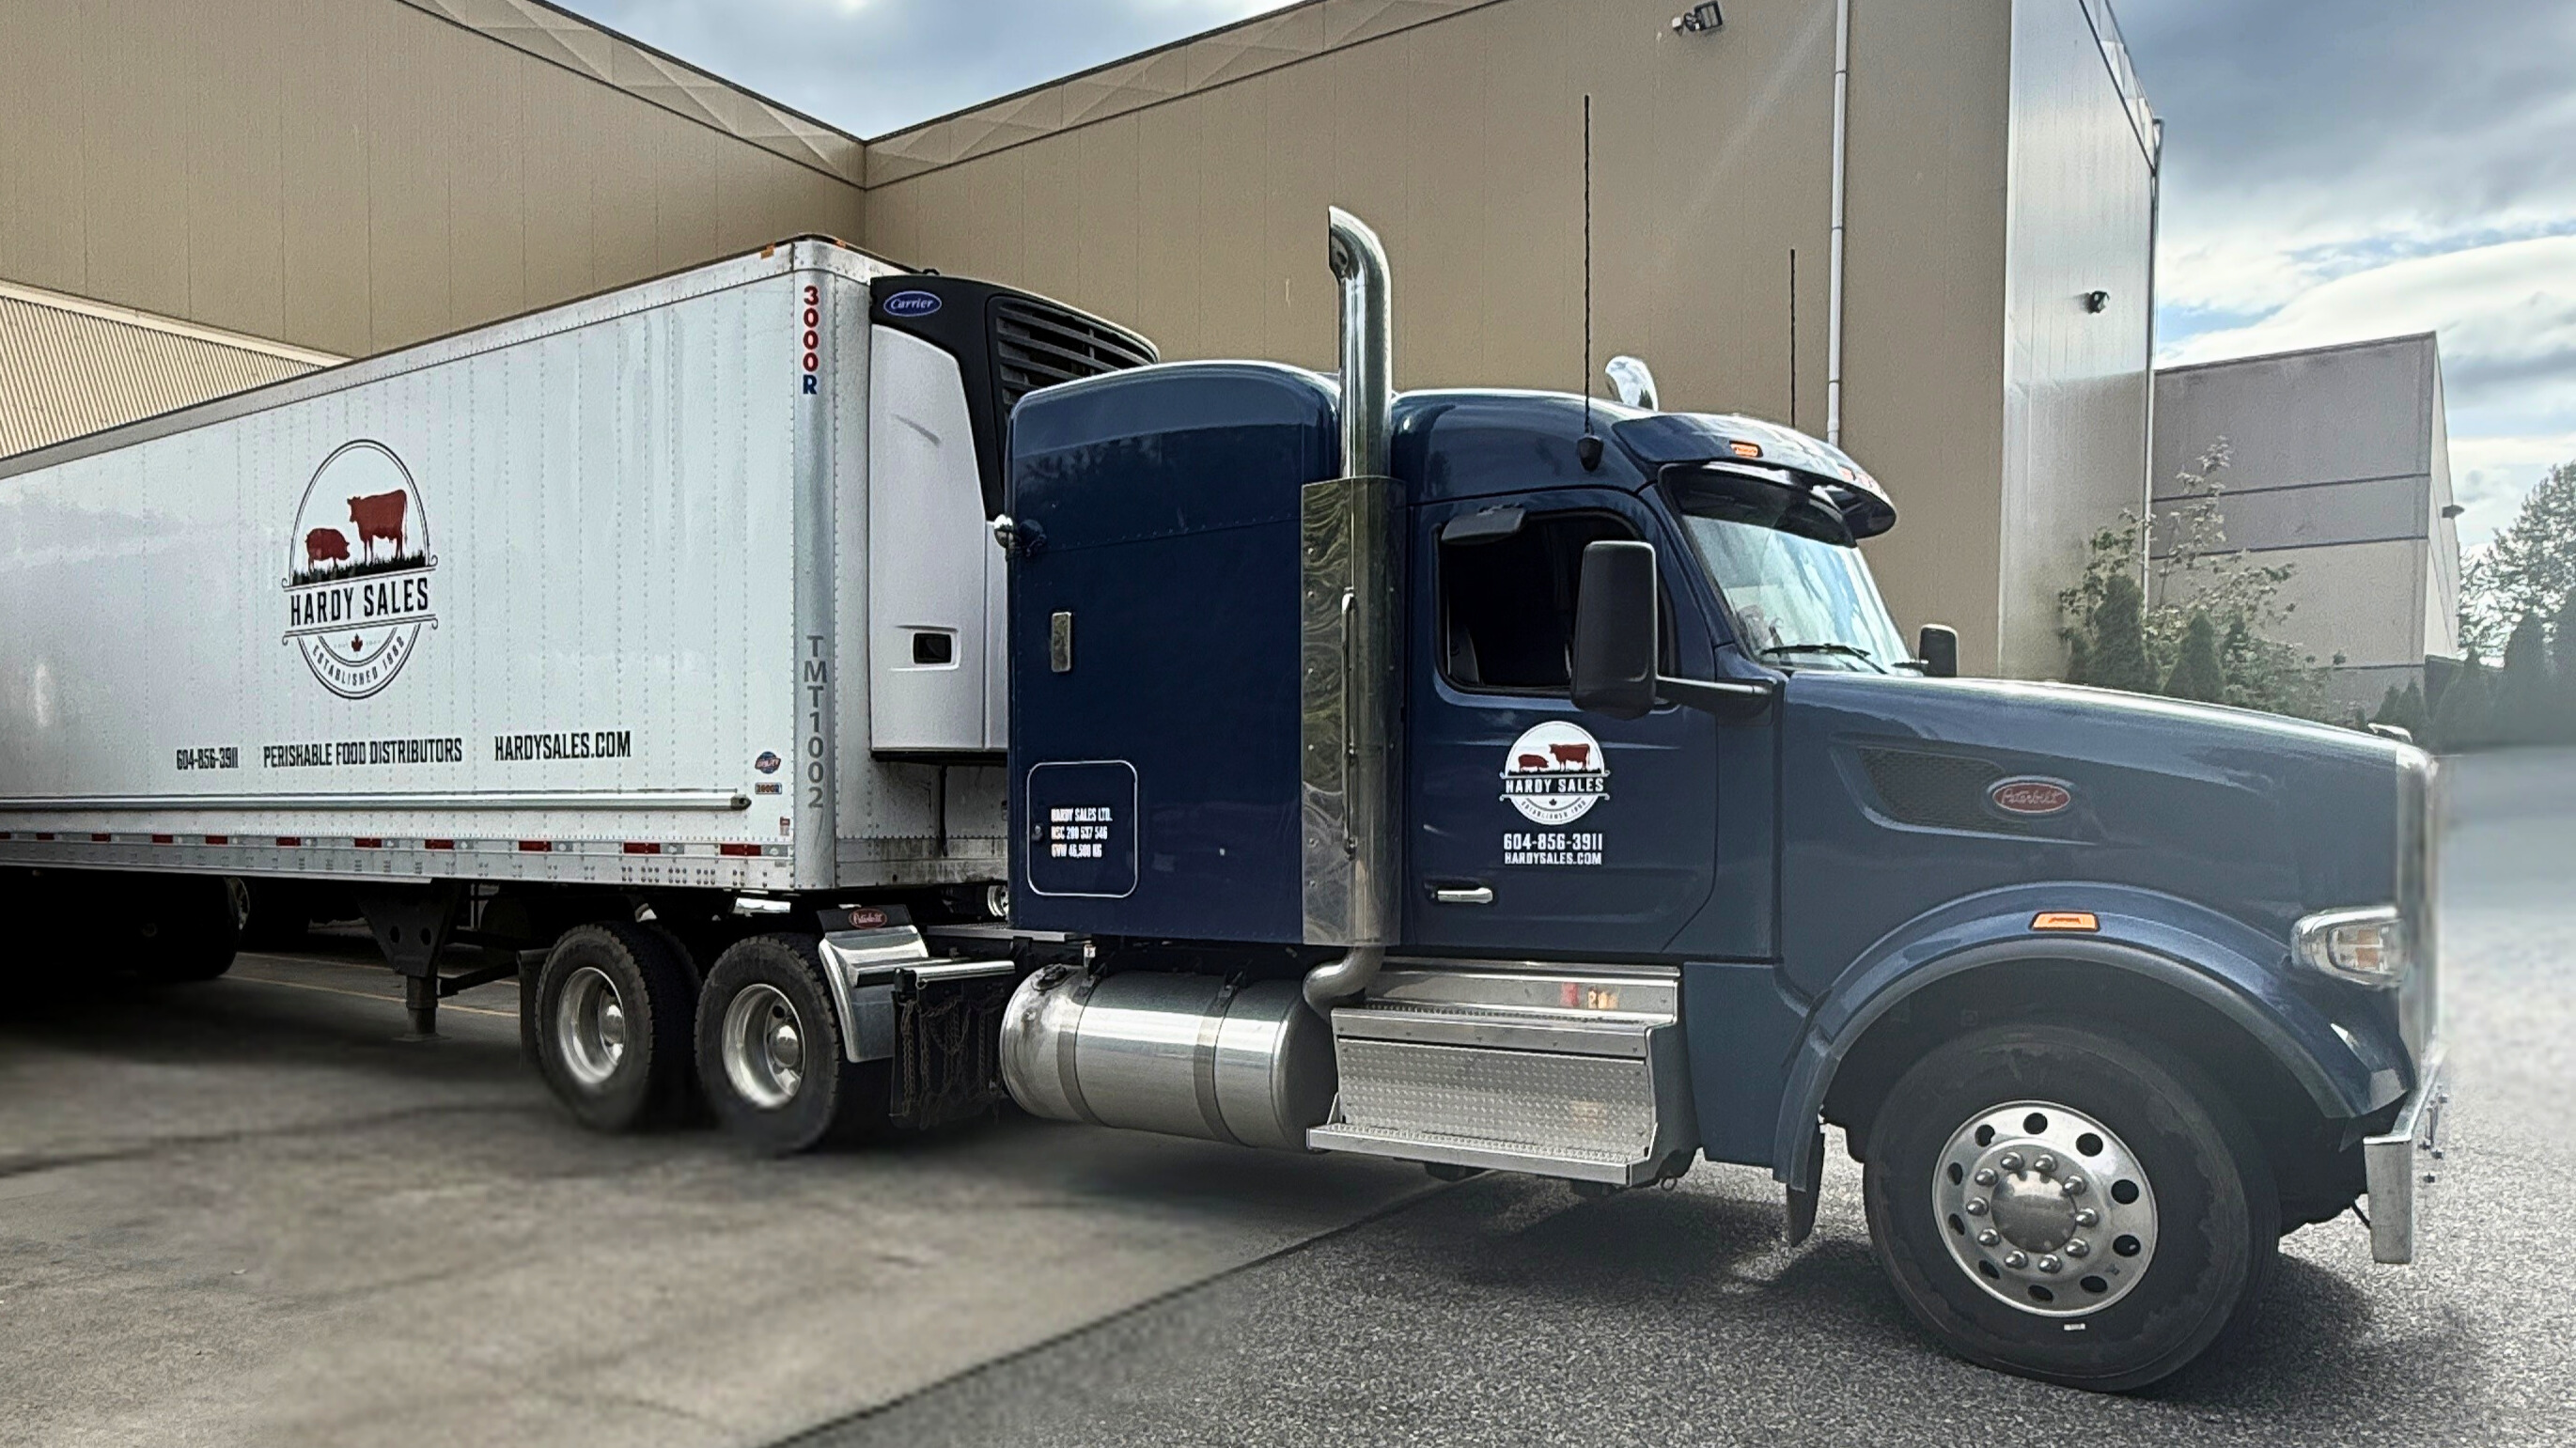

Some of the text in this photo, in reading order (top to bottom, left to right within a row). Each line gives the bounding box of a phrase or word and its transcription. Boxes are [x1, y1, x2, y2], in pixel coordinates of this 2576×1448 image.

[890, 298, 933, 310] Carrier
[803, 285, 820, 395] 3000R
[290, 577, 429, 627] HARDY SALES
[313, 645, 378, 686] ESTABLISHED
[804, 635, 828, 808] TMT1002
[176, 747, 239, 770] 604-856-3911
[263, 738, 462, 768] PERISHABLE FOOD DISTRIBUTORS
[494, 730, 632, 761] HARDYSALES.COM
[1506, 778, 1604, 793] HARDY SALES
[1074, 807, 1097, 822] SALES
[1098, 807, 1113, 821] LTD.
[1504, 833, 1603, 850] 604-856-3911
[1504, 852, 1602, 865] HARDYSALES.COM
